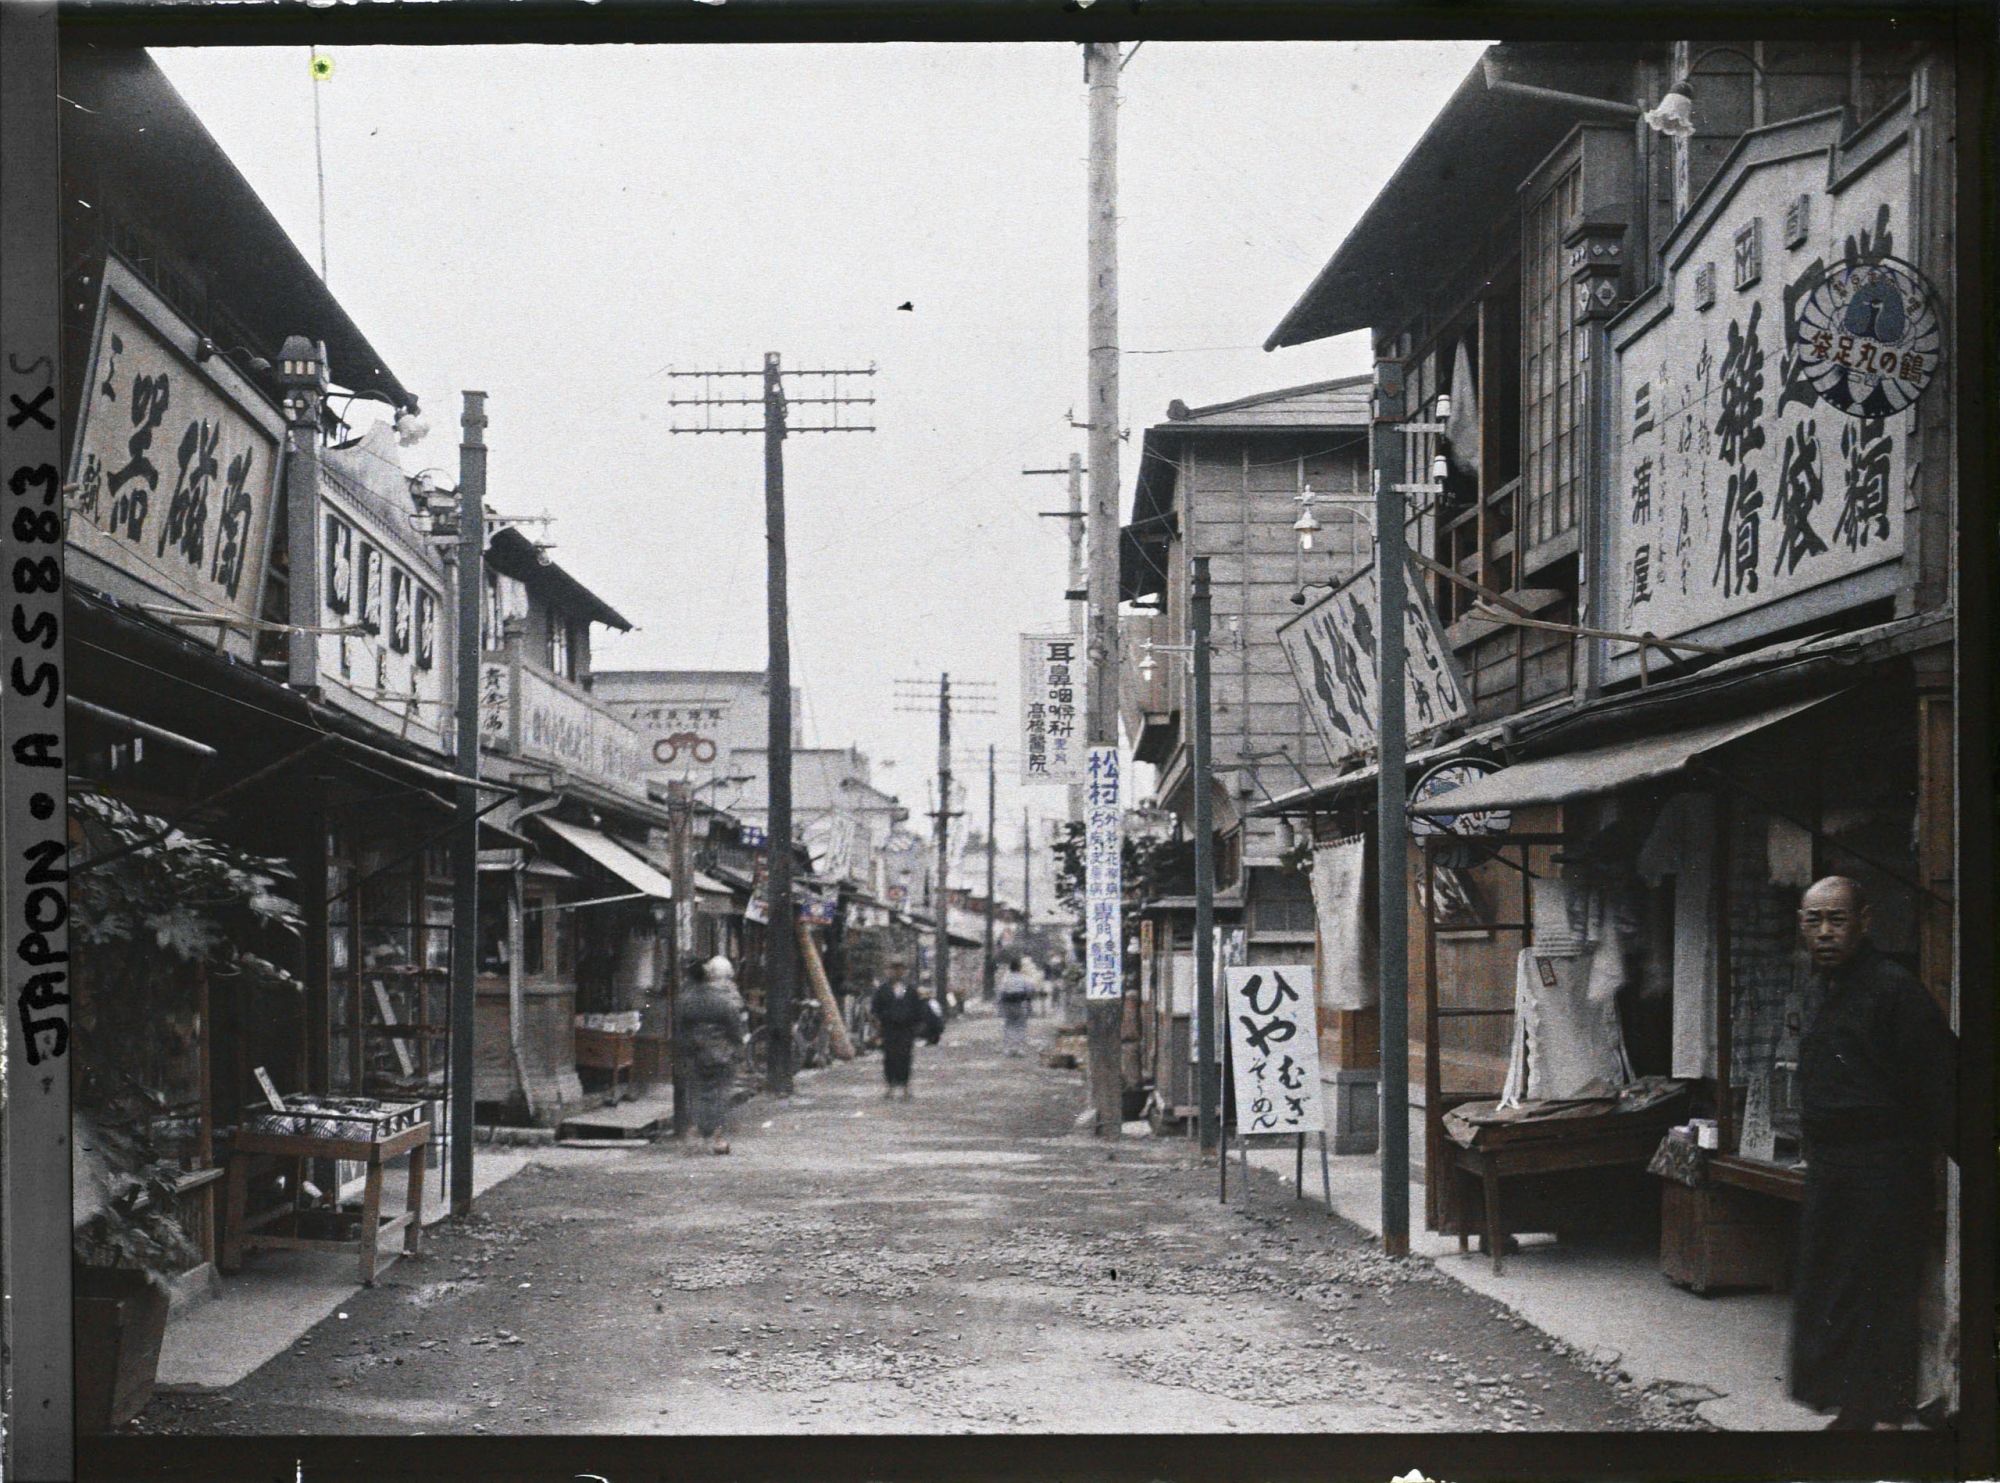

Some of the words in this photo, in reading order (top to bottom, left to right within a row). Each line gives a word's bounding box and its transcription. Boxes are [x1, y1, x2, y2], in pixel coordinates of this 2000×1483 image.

[1046, 642, 1075, 737] 耳鼻咽喉科
[12, 733, 63, 768] A
[18, 838, 68, 1066] JAPON
[1239, 970, 1299, 1057] ひや
